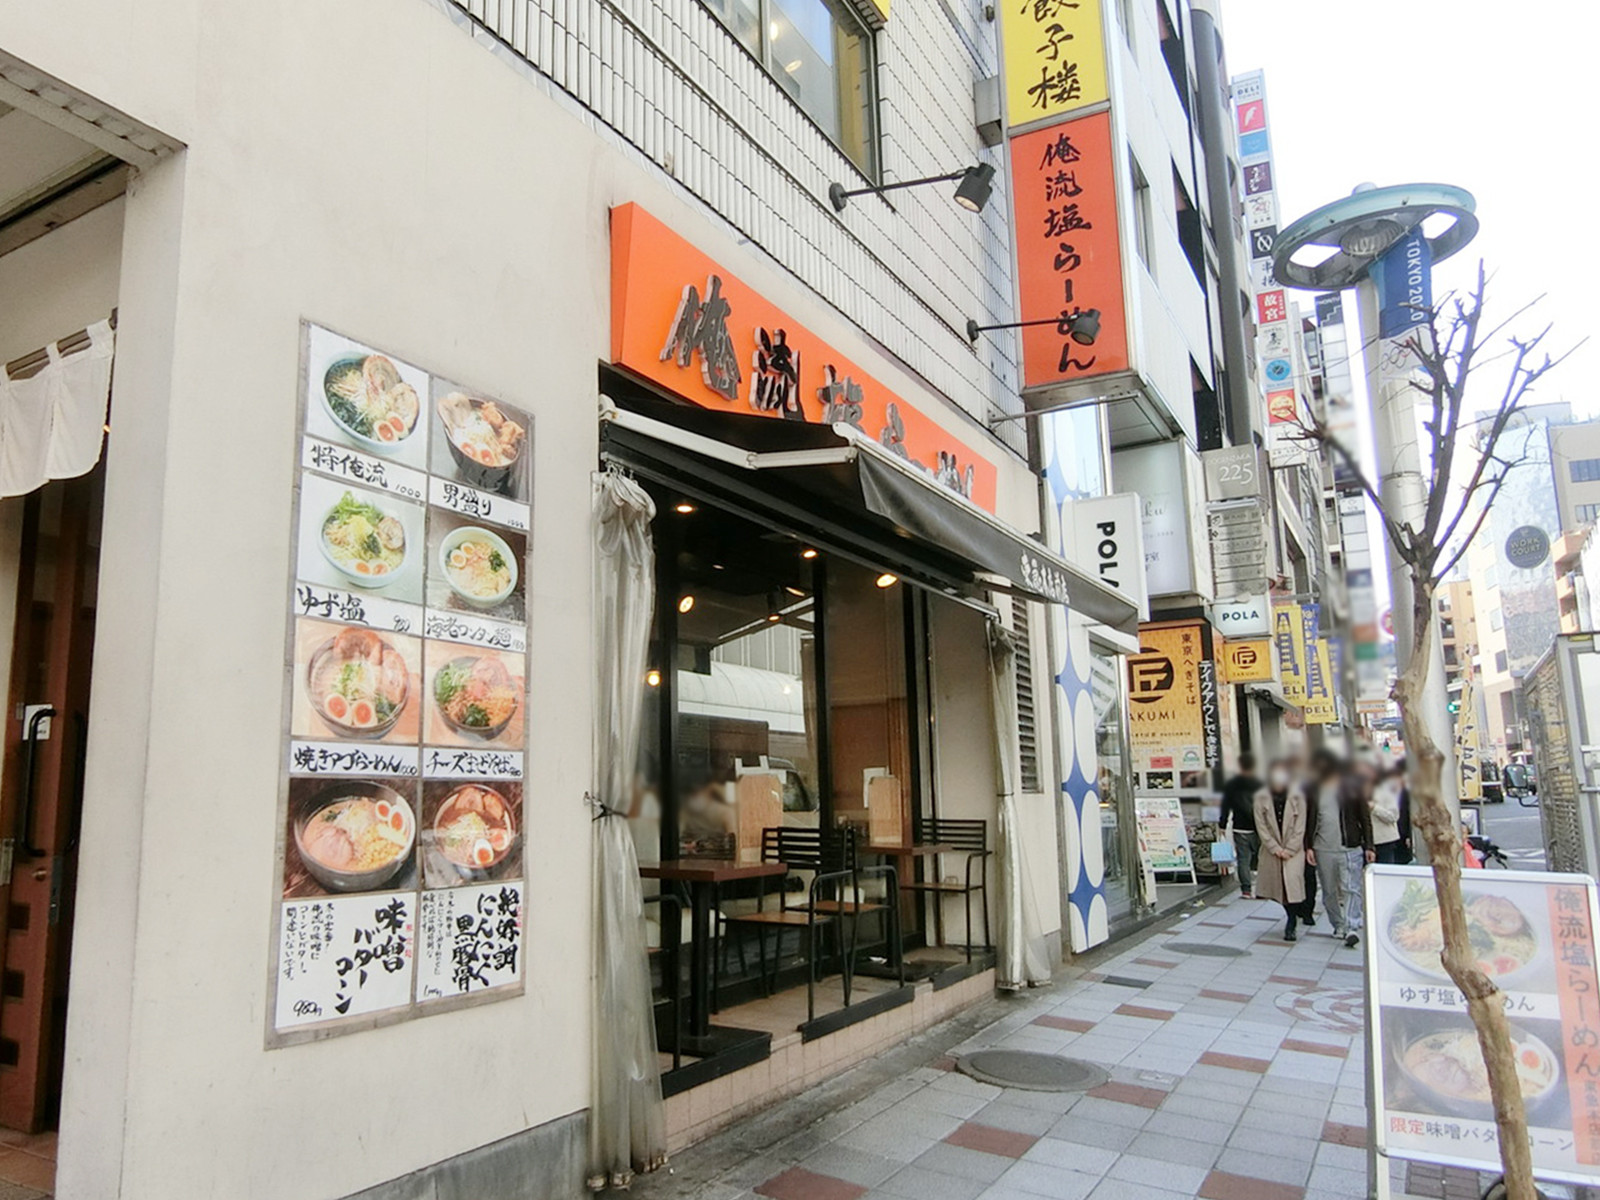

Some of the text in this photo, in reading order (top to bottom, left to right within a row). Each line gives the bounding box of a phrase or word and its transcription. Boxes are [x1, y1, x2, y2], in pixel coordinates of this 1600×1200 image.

[1406, 239, 1422, 286] TOKYO
[1219, 463, 1253, 484] 225
[443, 483, 492, 518] 男盛り
[297, 586, 369, 626] ゆず塩
[1222, 610, 1260, 621] POLA
[1283, 685, 1305, 695] ELI
[1306, 705, 1334, 714] DELI
[375, 897, 407, 974] 味噌
[1554, 888, 1600, 1078] 俺流塩らーめん
